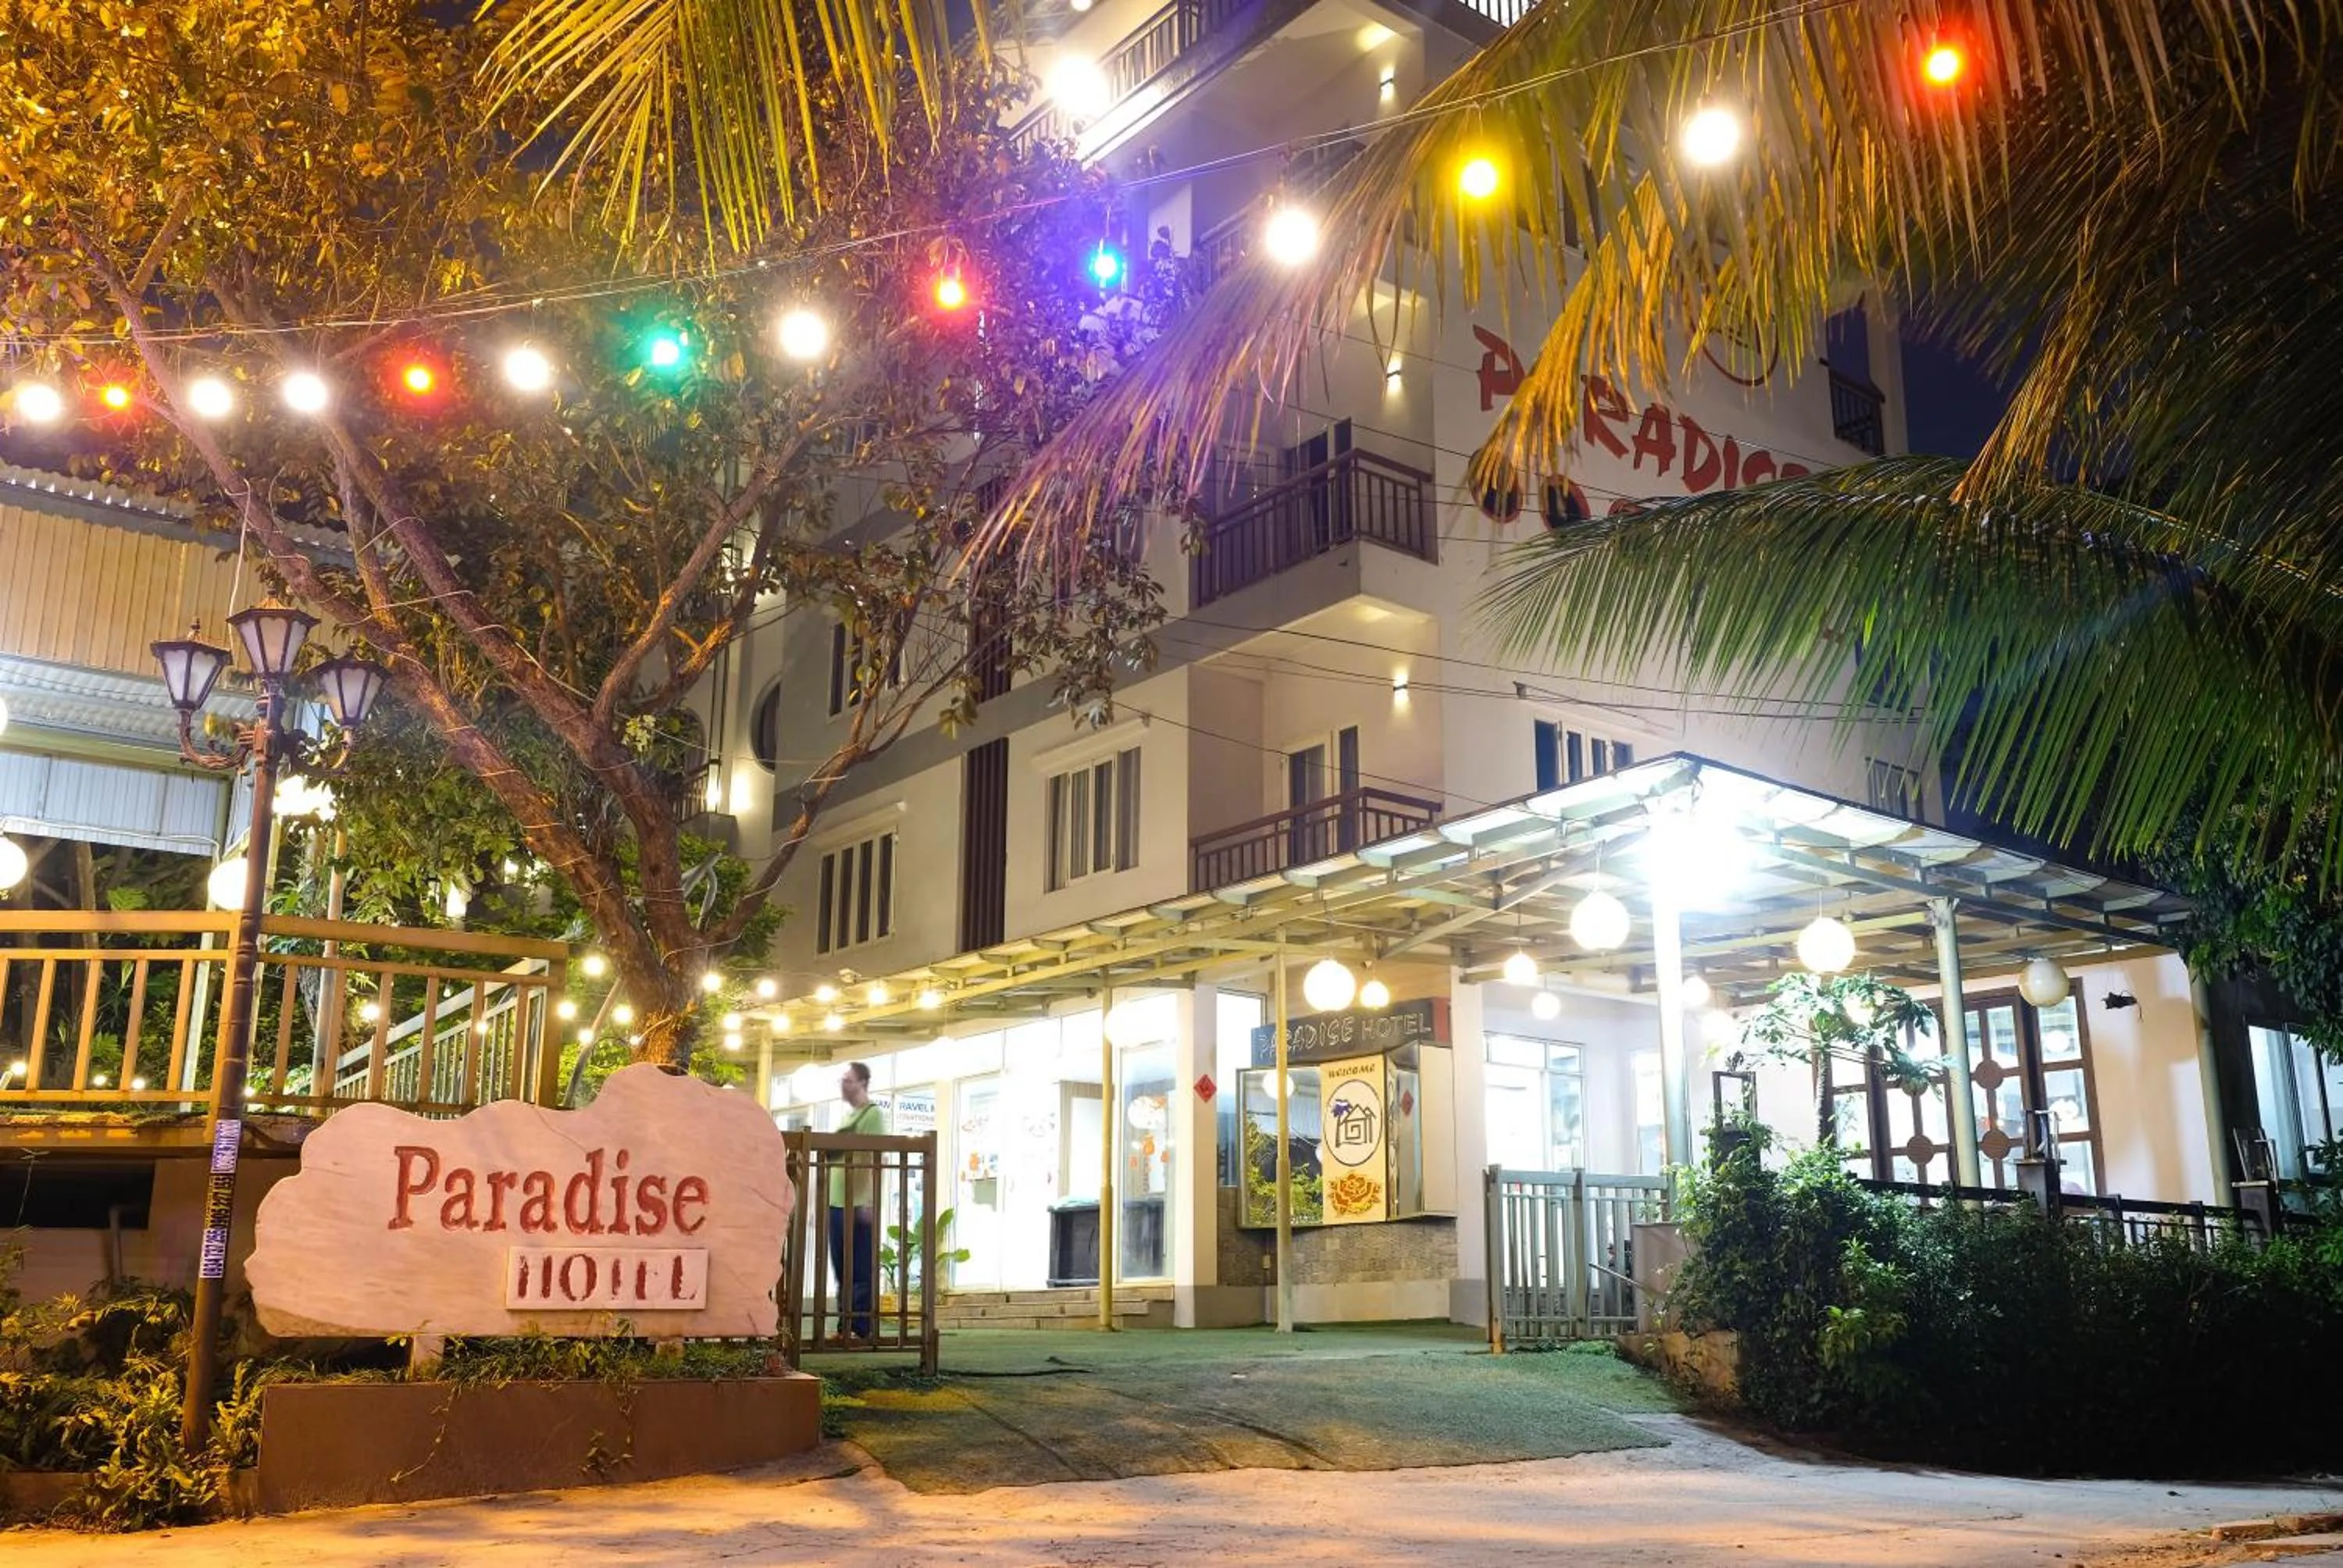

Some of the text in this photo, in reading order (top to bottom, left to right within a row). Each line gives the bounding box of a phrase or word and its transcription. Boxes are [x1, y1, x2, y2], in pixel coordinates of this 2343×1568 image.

[1473, 324, 1810, 493] PRADI
[1361, 1012, 1432, 1040] HOTEL
[1328, 1063, 1375, 1078] WELCOME
[898, 1102, 929, 1113] RAVEL
[387, 1146, 709, 1235] Paradise
